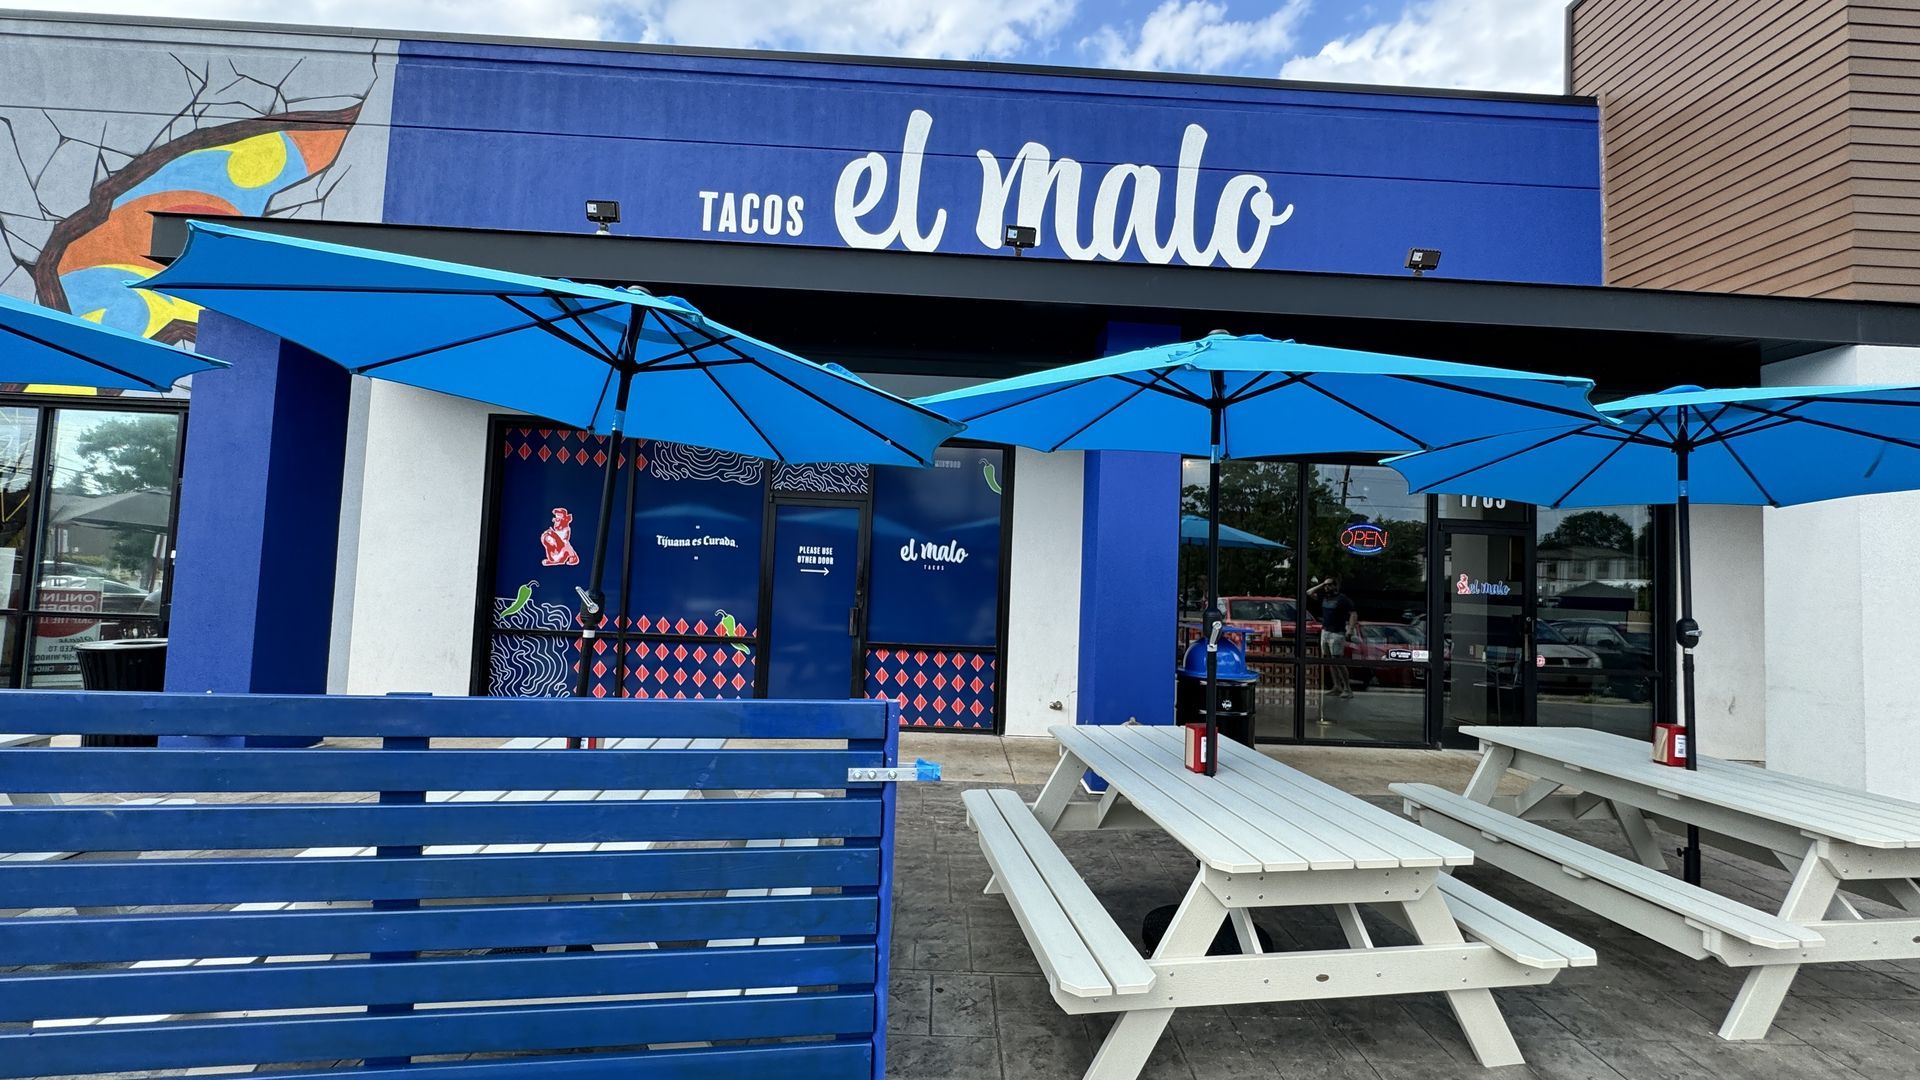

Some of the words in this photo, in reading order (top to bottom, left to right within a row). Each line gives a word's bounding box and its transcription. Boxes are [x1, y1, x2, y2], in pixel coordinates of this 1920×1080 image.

[699, 190, 803, 237] TACOS
[834, 109, 947, 252] el
[976, 124, 1294, 269] malo
[656, 535, 691, 548] Tijuana
[692, 537, 702, 546] es
[1340, 530, 1389, 547] OPEN
[799, 545, 821, 555] PLEASE
[821, 547, 833, 555] USE
[900, 538, 918, 561] el
[920, 539, 969, 564] malo
[797, 555, 817, 564] OTHER
[817, 556, 834, 565] DOOR
